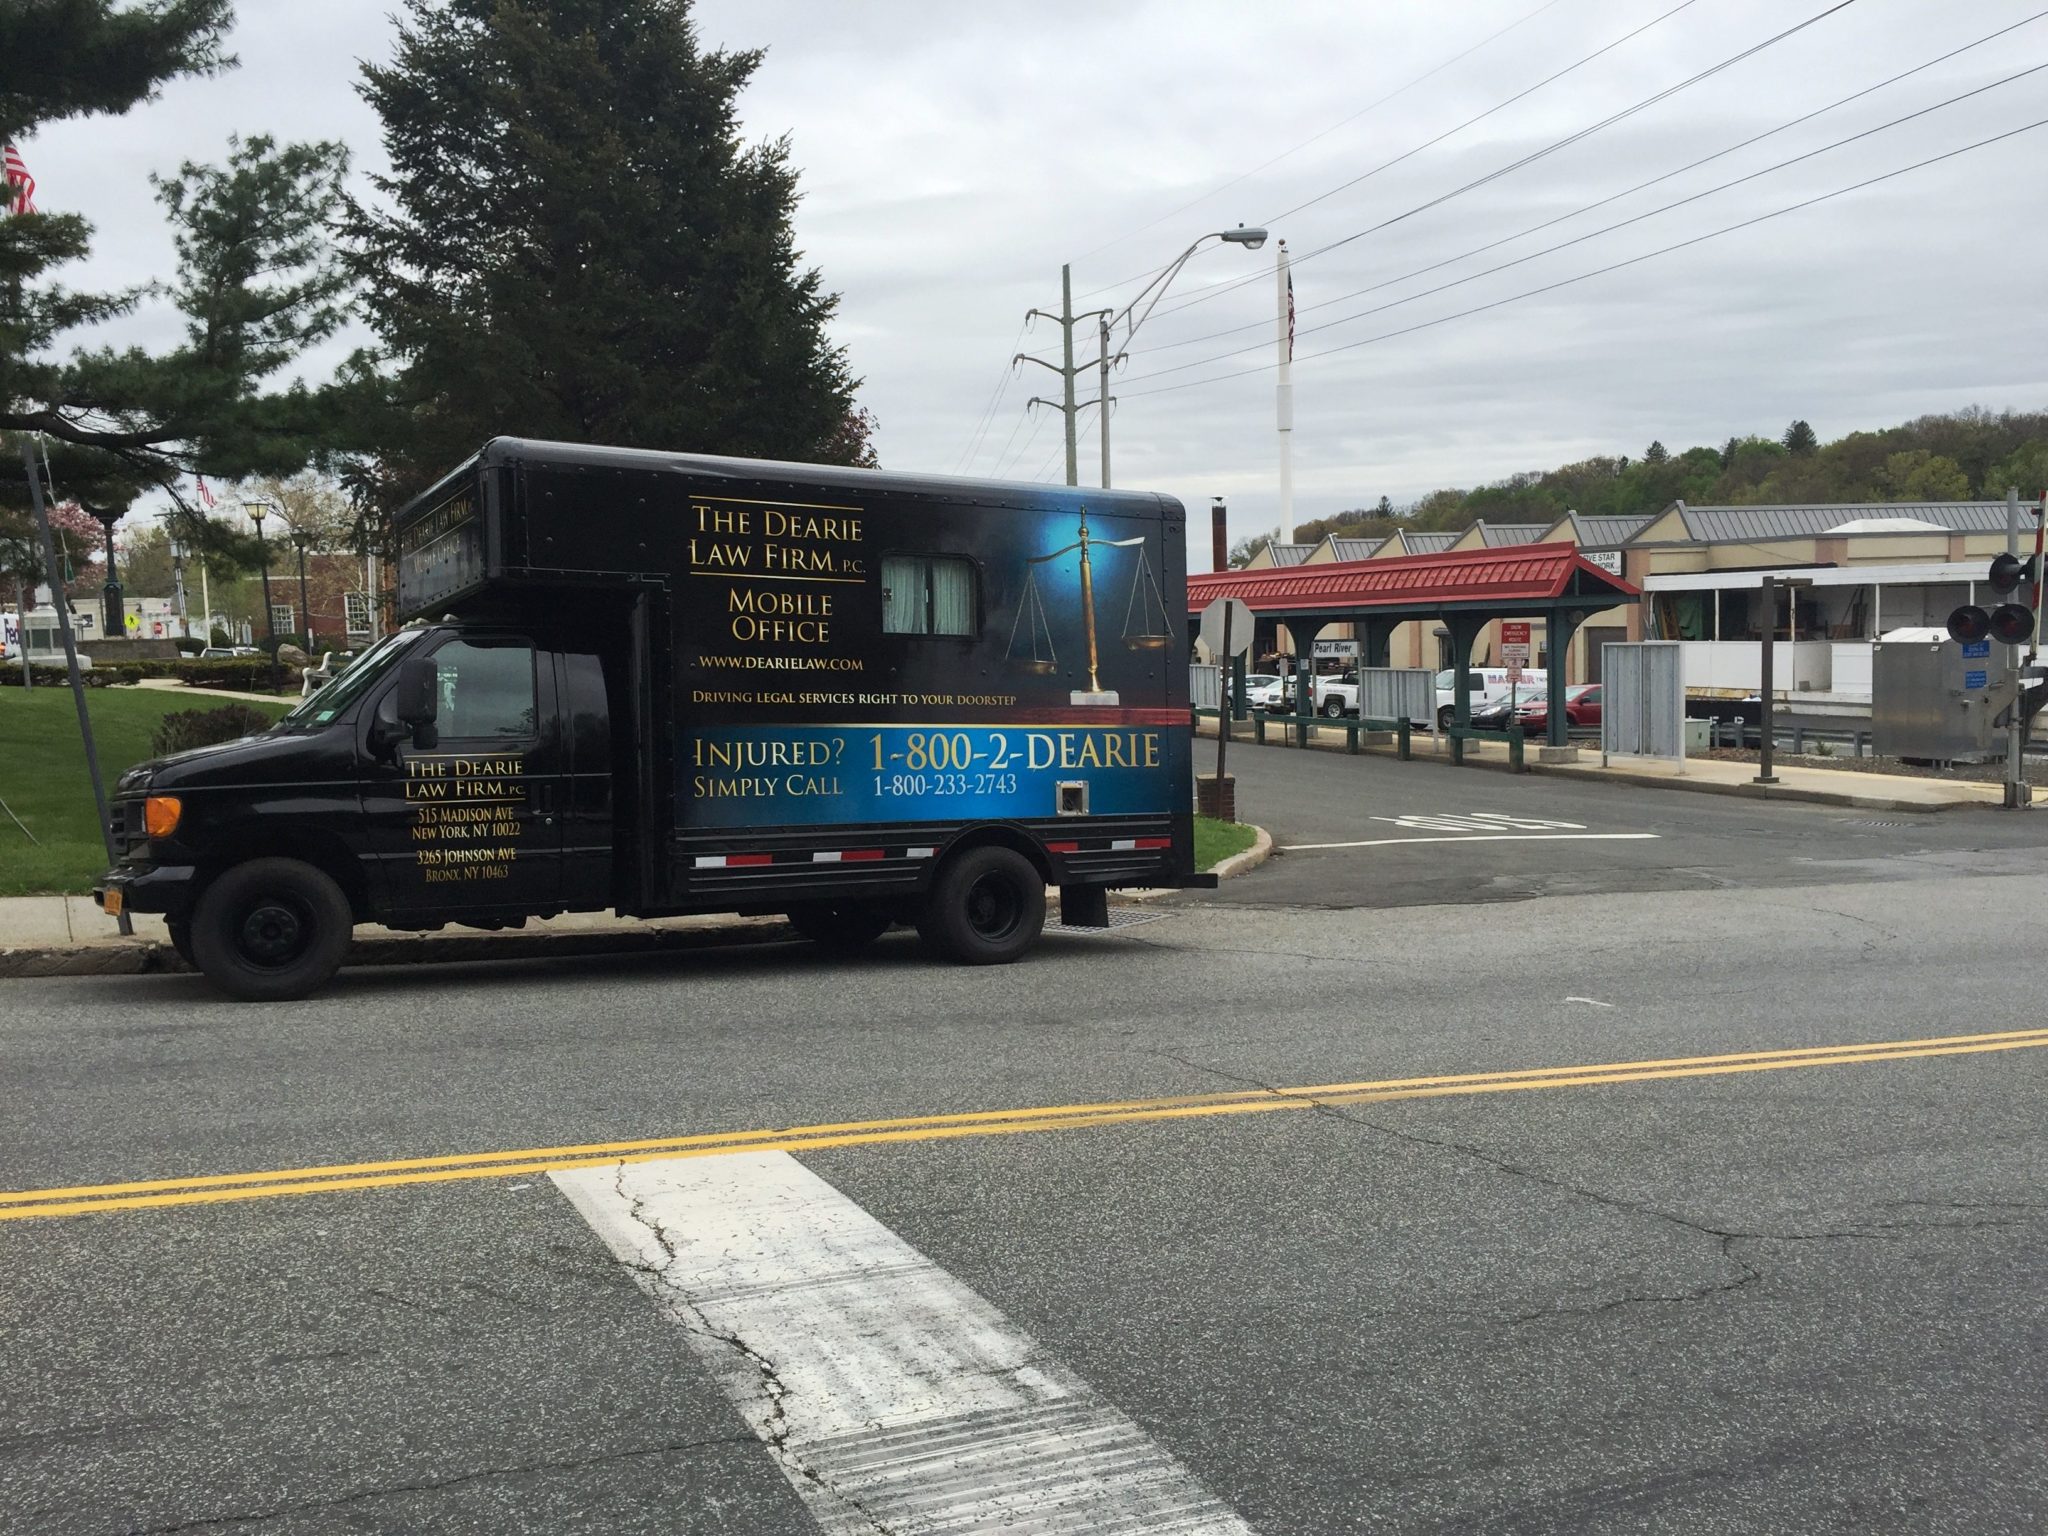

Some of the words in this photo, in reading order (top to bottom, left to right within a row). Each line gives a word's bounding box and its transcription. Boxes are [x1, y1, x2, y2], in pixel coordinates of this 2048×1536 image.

[692, 505, 750, 534] THE
[764, 511, 863, 541] DEARIE
[688, 538, 752, 567] LAW
[843, 559, 866, 573] P.C.
[1598, 553, 1616, 561] STAR
[728, 588, 833, 616] MOBILE
[732, 615, 830, 643] OFFICE
[1314, 643, 1332, 653] Pearl
[1334, 643, 1352, 653] River
[699, 656, 864, 671] WWW.DEARIELAW.COM
[1487, 674, 1535, 684] MAER
[693, 690, 752, 703] DRIVING
[757, 692, 796, 704] LEGAL
[799, 693, 855, 704] SERVICES
[858, 694, 898, 704] RIGHT
[901, 694, 918, 705] TO
[921, 695, 953, 705] YOUR
[957, 695, 1017, 706] DOORSTEP
[694, 737, 845, 773] INJURED?
[869, 732, 1160, 770] 1-800-2-DEARIE
[405, 761, 446, 777] THE
[455, 760, 523, 776] DEARIE
[405, 782, 447, 798] LAW
[694, 775, 778, 798] SIMPLY
[786, 774, 844, 796] CALL
[873, 773, 1017, 796] 1-800-233-2743
[419, 807, 437, 824] 515
[440, 807, 492, 823] MADISON
[495, 806, 514, 820] AVE
[412, 826, 437, 840] NEW
[439, 825, 470, 839] YORK,
[473, 823, 489, 837] NY
[492, 822, 520, 836] 10022
[417, 849, 441, 865] 3265
[444, 848, 494, 867] JOHNSON
[497, 846, 517, 860] AVE
[464, 866, 480, 879] NY
[482, 864, 509, 879] 10463
